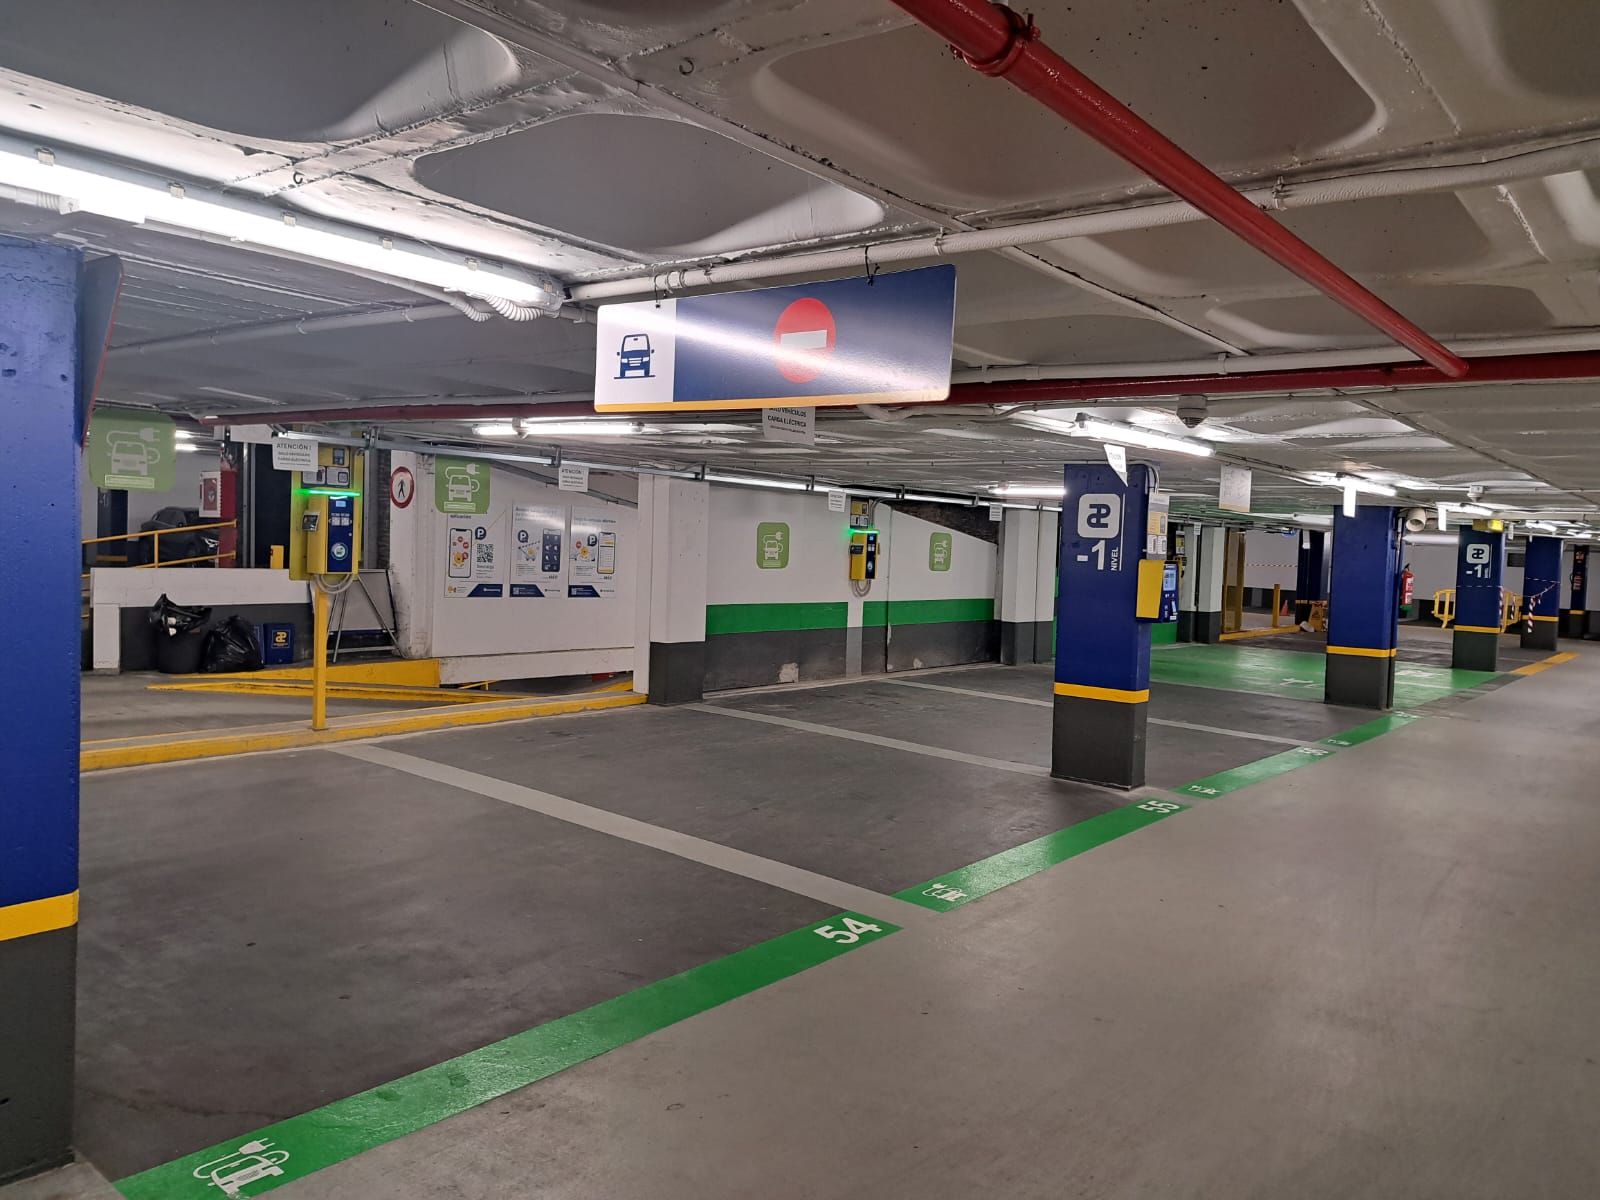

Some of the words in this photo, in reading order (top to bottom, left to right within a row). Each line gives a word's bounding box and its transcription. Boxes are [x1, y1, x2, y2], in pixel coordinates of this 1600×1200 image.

[1076, 539, 1106, 571] -1
[1110, 546, 1119, 571] NIVEL
[1136, 800, 1180, 813] 55
[813, 917, 883, 944] 54
